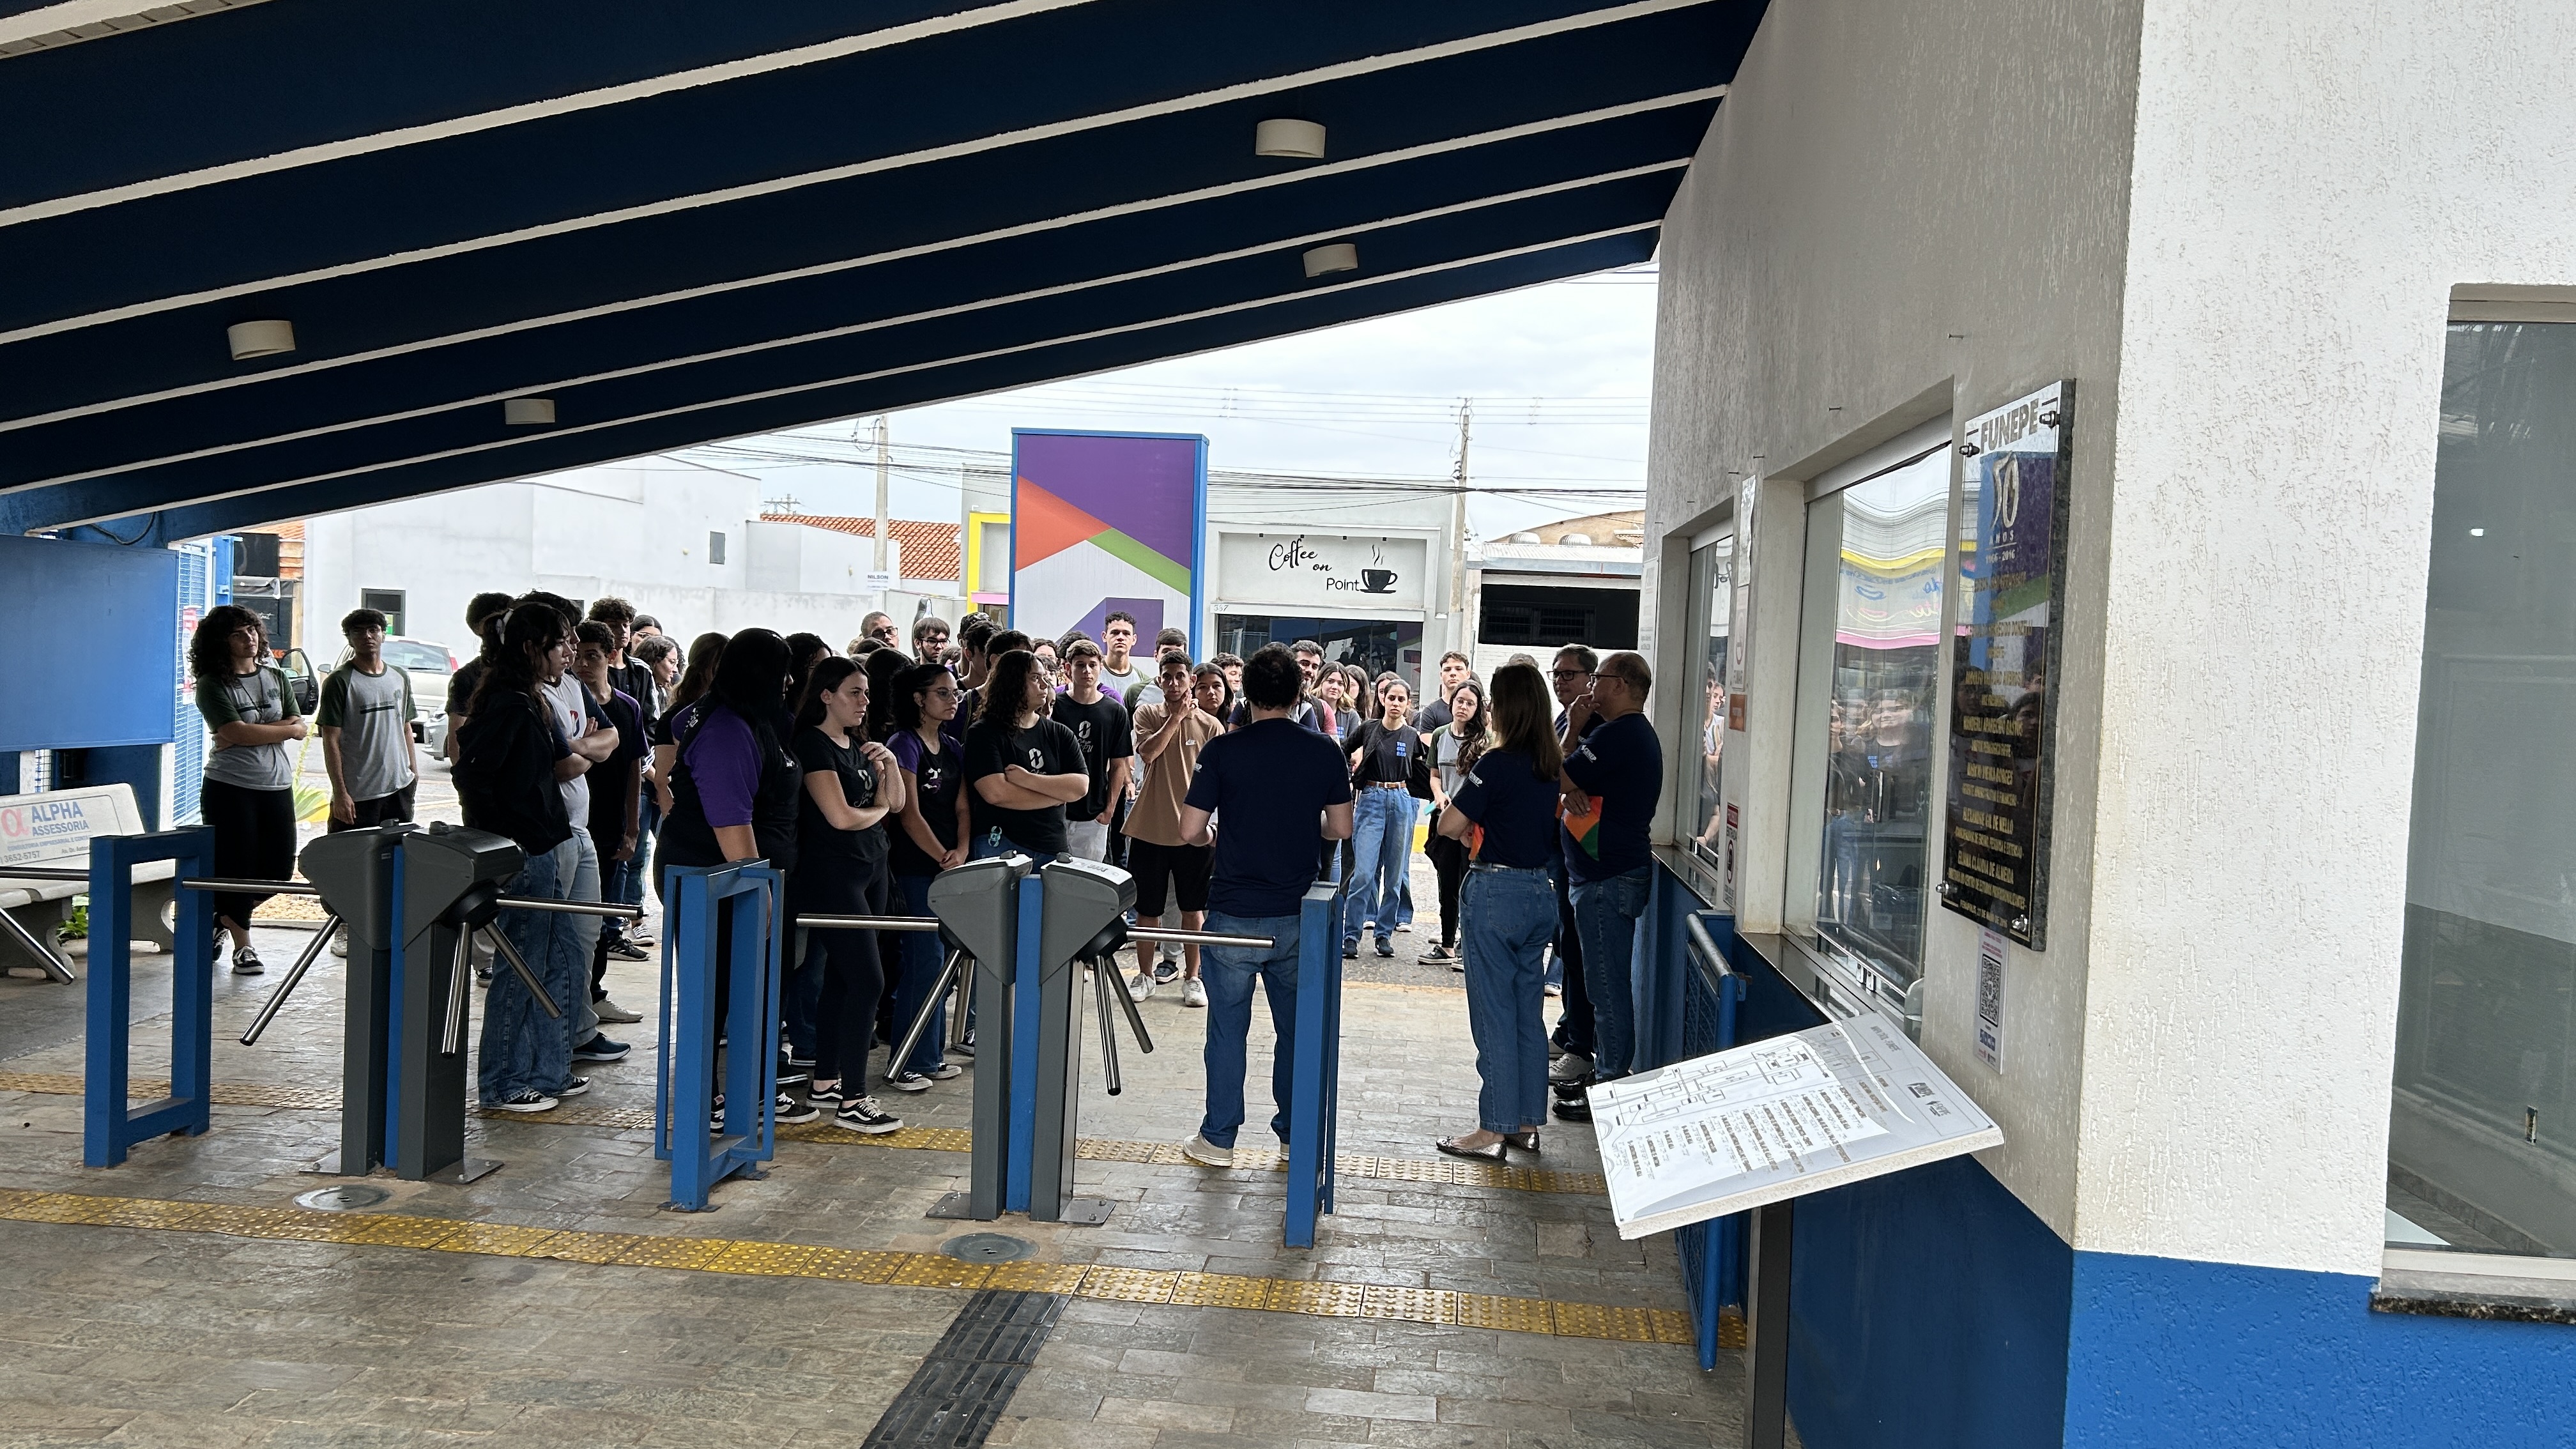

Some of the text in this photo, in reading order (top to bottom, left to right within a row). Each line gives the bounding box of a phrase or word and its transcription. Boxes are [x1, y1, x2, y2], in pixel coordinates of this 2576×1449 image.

[1980, 398, 2039, 454] FUNEPE
[1268, 539, 1318, 571] Coffee
[1312, 564, 1332, 572] on
[1326, 578, 1360, 592] Point
[31, 801, 84, 823] ALPHA
[32, 820, 90, 836] ASSESSORIA
[4, 850, 40, 862] 3652-5757
